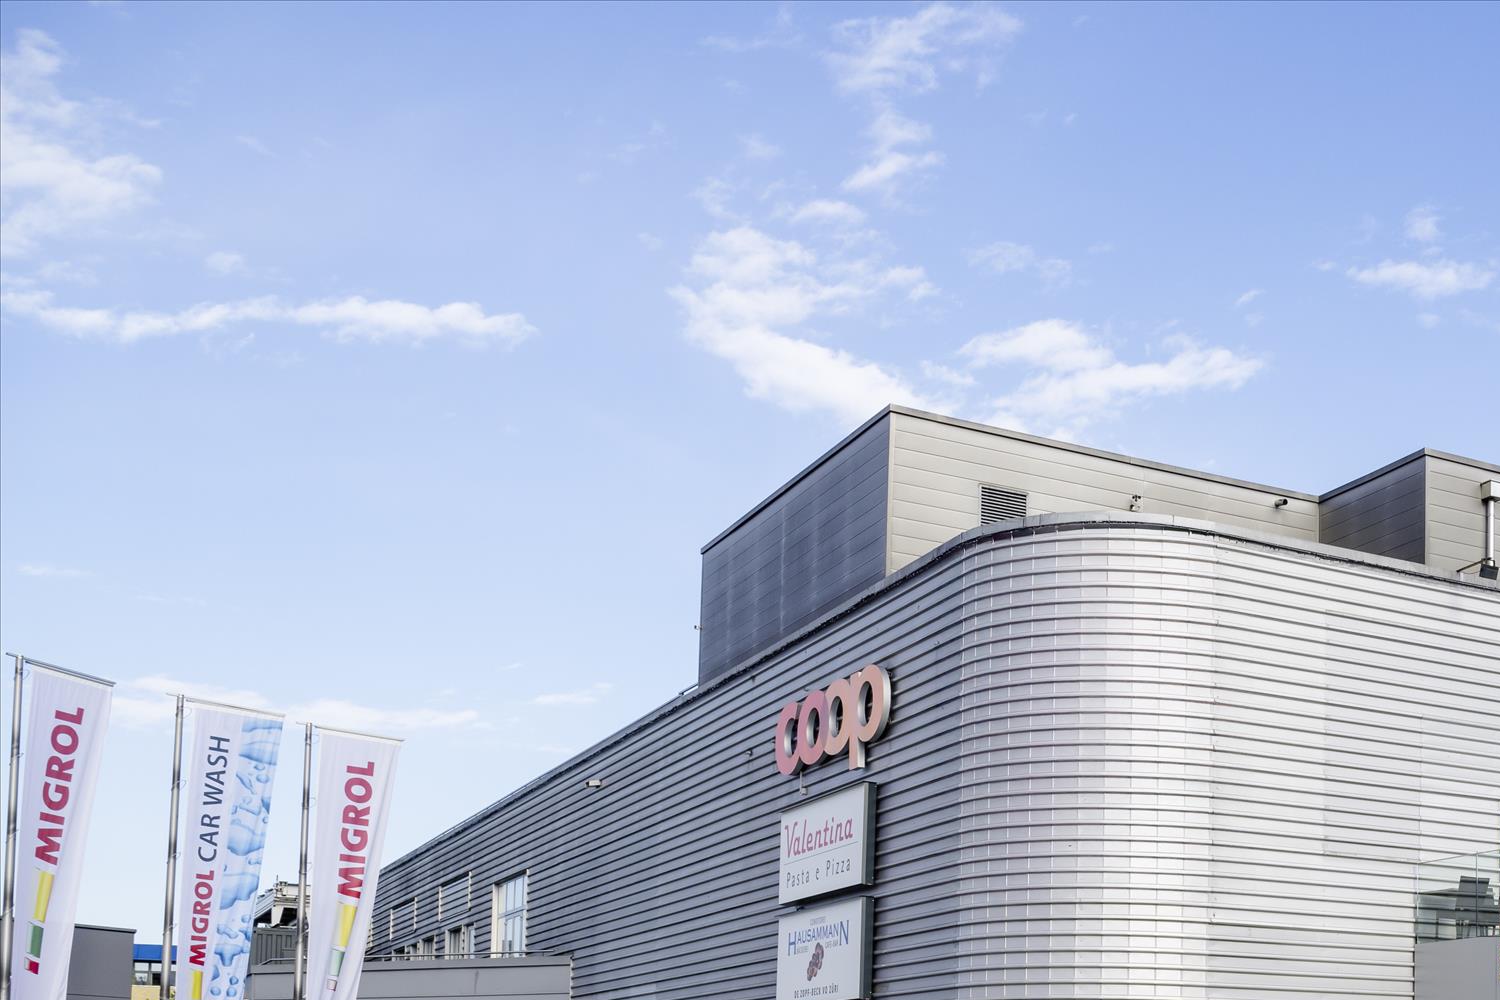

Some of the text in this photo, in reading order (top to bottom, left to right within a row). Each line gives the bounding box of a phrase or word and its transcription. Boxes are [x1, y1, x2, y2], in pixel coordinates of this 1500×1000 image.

[775, 664, 891, 776] coop
[35, 706, 85, 866] MIGROL
[337, 760, 376, 900] MIGROL
[784, 816, 854, 859] Valentina
[189, 735, 231, 967] MIGROL CAR WASH
[786, 858, 851, 888] Pasta e Pizza
[787, 919, 850, 957] HAUSAMMANN
